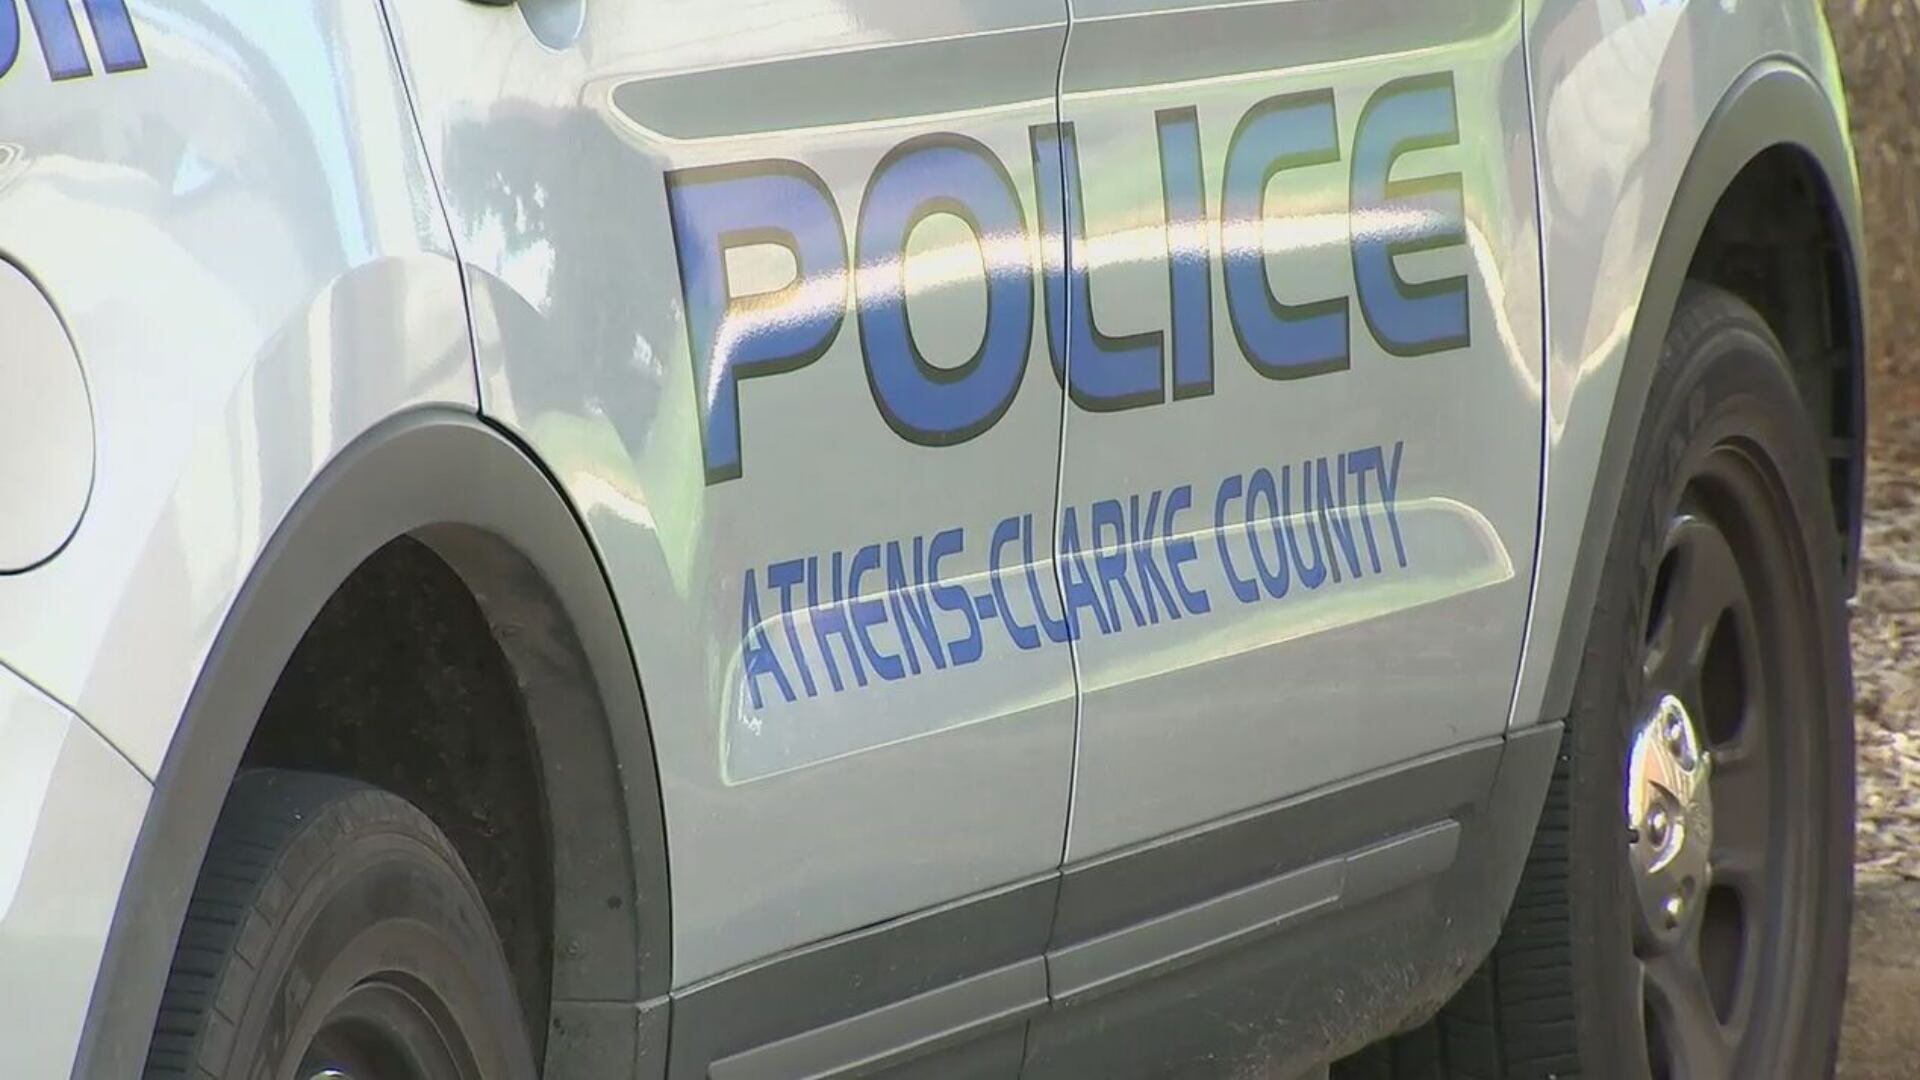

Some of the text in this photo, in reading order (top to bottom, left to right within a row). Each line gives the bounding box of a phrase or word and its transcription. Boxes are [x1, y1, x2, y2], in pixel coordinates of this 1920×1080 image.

[664, 70, 1471, 486] POLICE
[741, 441, 1407, 709] ATHENS-CLARKE COUNTY
